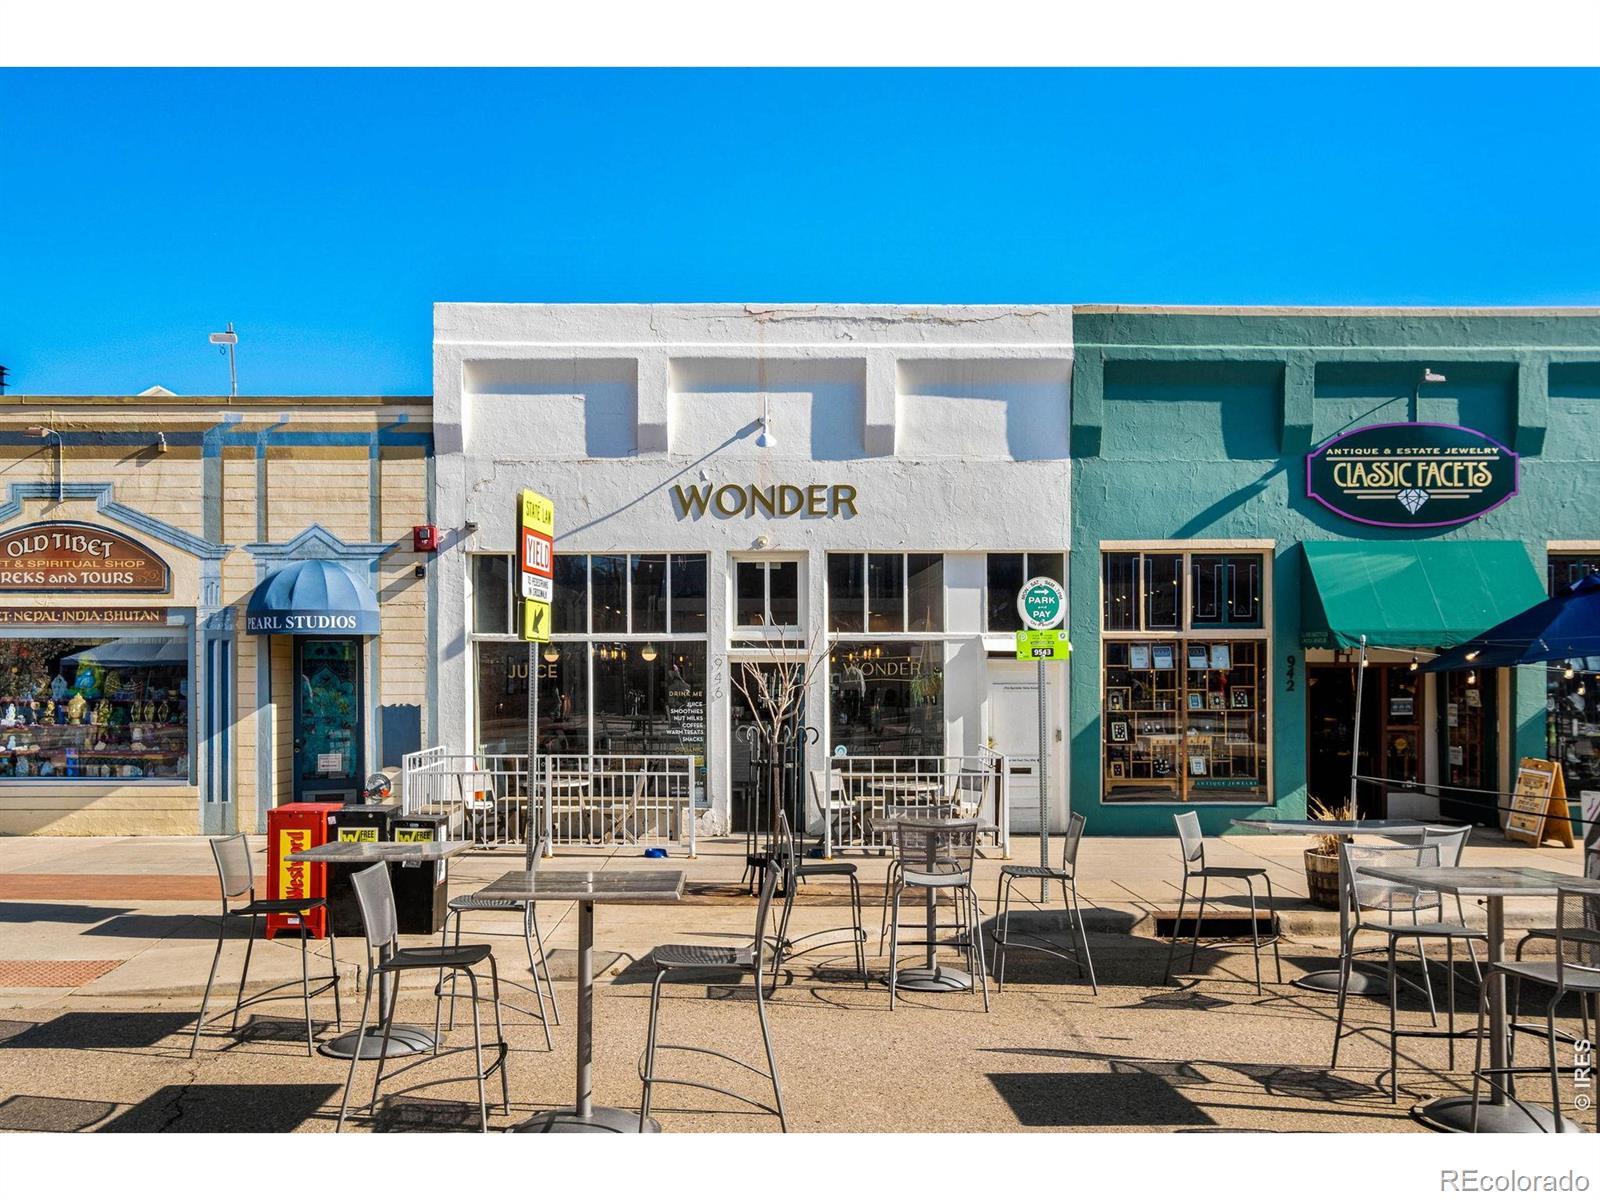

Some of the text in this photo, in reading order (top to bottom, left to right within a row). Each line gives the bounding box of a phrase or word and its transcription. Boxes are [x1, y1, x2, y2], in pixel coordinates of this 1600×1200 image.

[1334, 462, 1492, 487] CLASSIC FACETS
[674, 483, 858, 517] WONDER
[7, 534, 114, 558] OLD TIBET
[528, 538, 549, 568] YIELD
[49, 572, 77, 583] and
[81, 571, 133, 584] TOURS
[248, 615, 356, 630] PEARL STUDIOS
[508, 664, 558, 678] JUCE
[842, 662, 921, 676] WONDER
[360, 830, 374, 838] FREE
